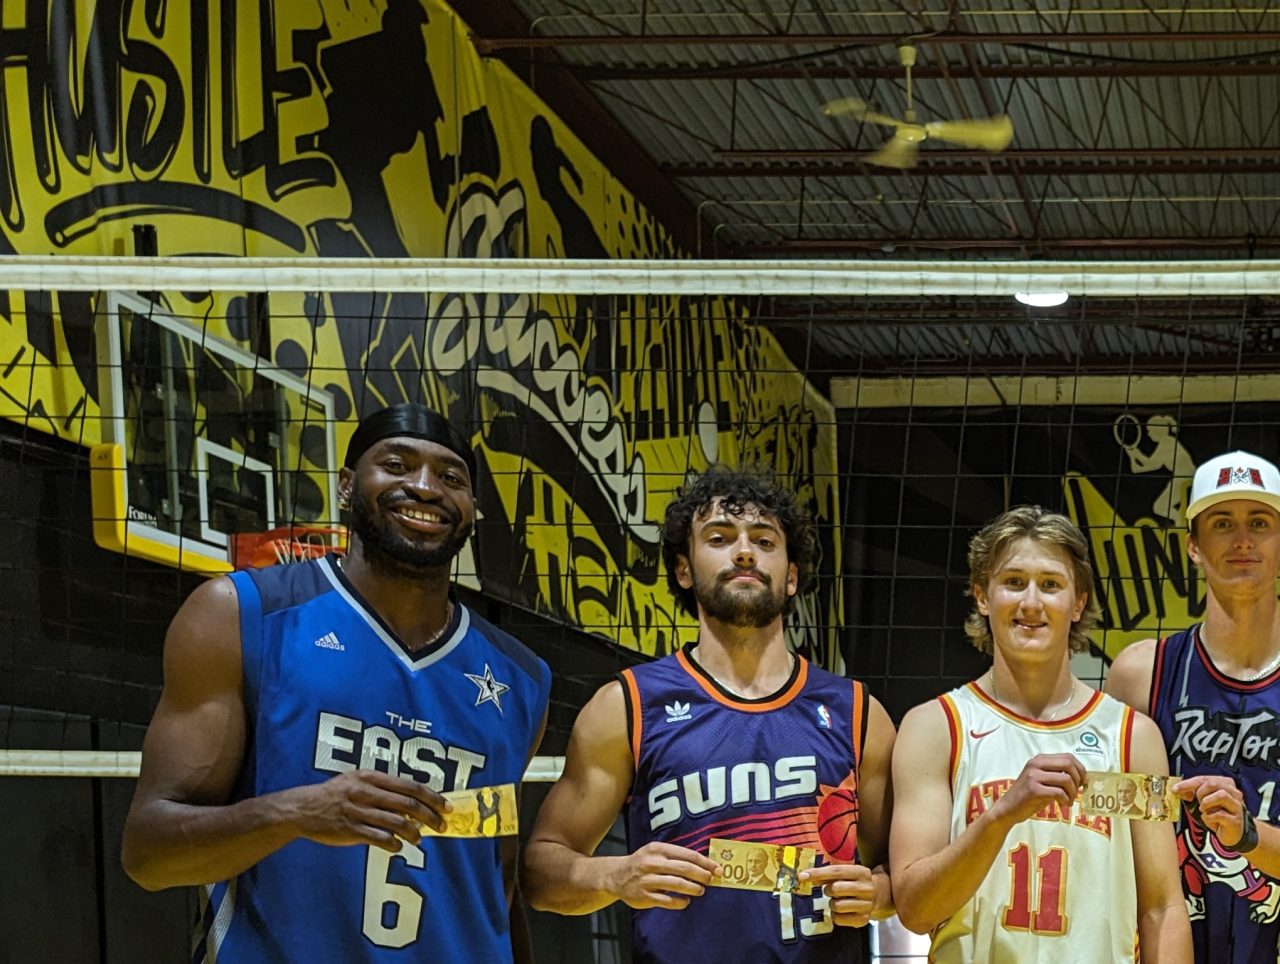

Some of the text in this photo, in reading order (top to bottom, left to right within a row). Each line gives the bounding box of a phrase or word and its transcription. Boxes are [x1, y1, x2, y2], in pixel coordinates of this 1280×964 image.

[315, 639, 345, 651] adidas
[385, 710, 433, 733] THE
[666, 713, 693, 724] adidas
[314, 711, 486, 793] EAST
[1090, 794, 1116, 810] 100
[362, 832, 425, 949] 6
[1002, 841, 1070, 936] 11
